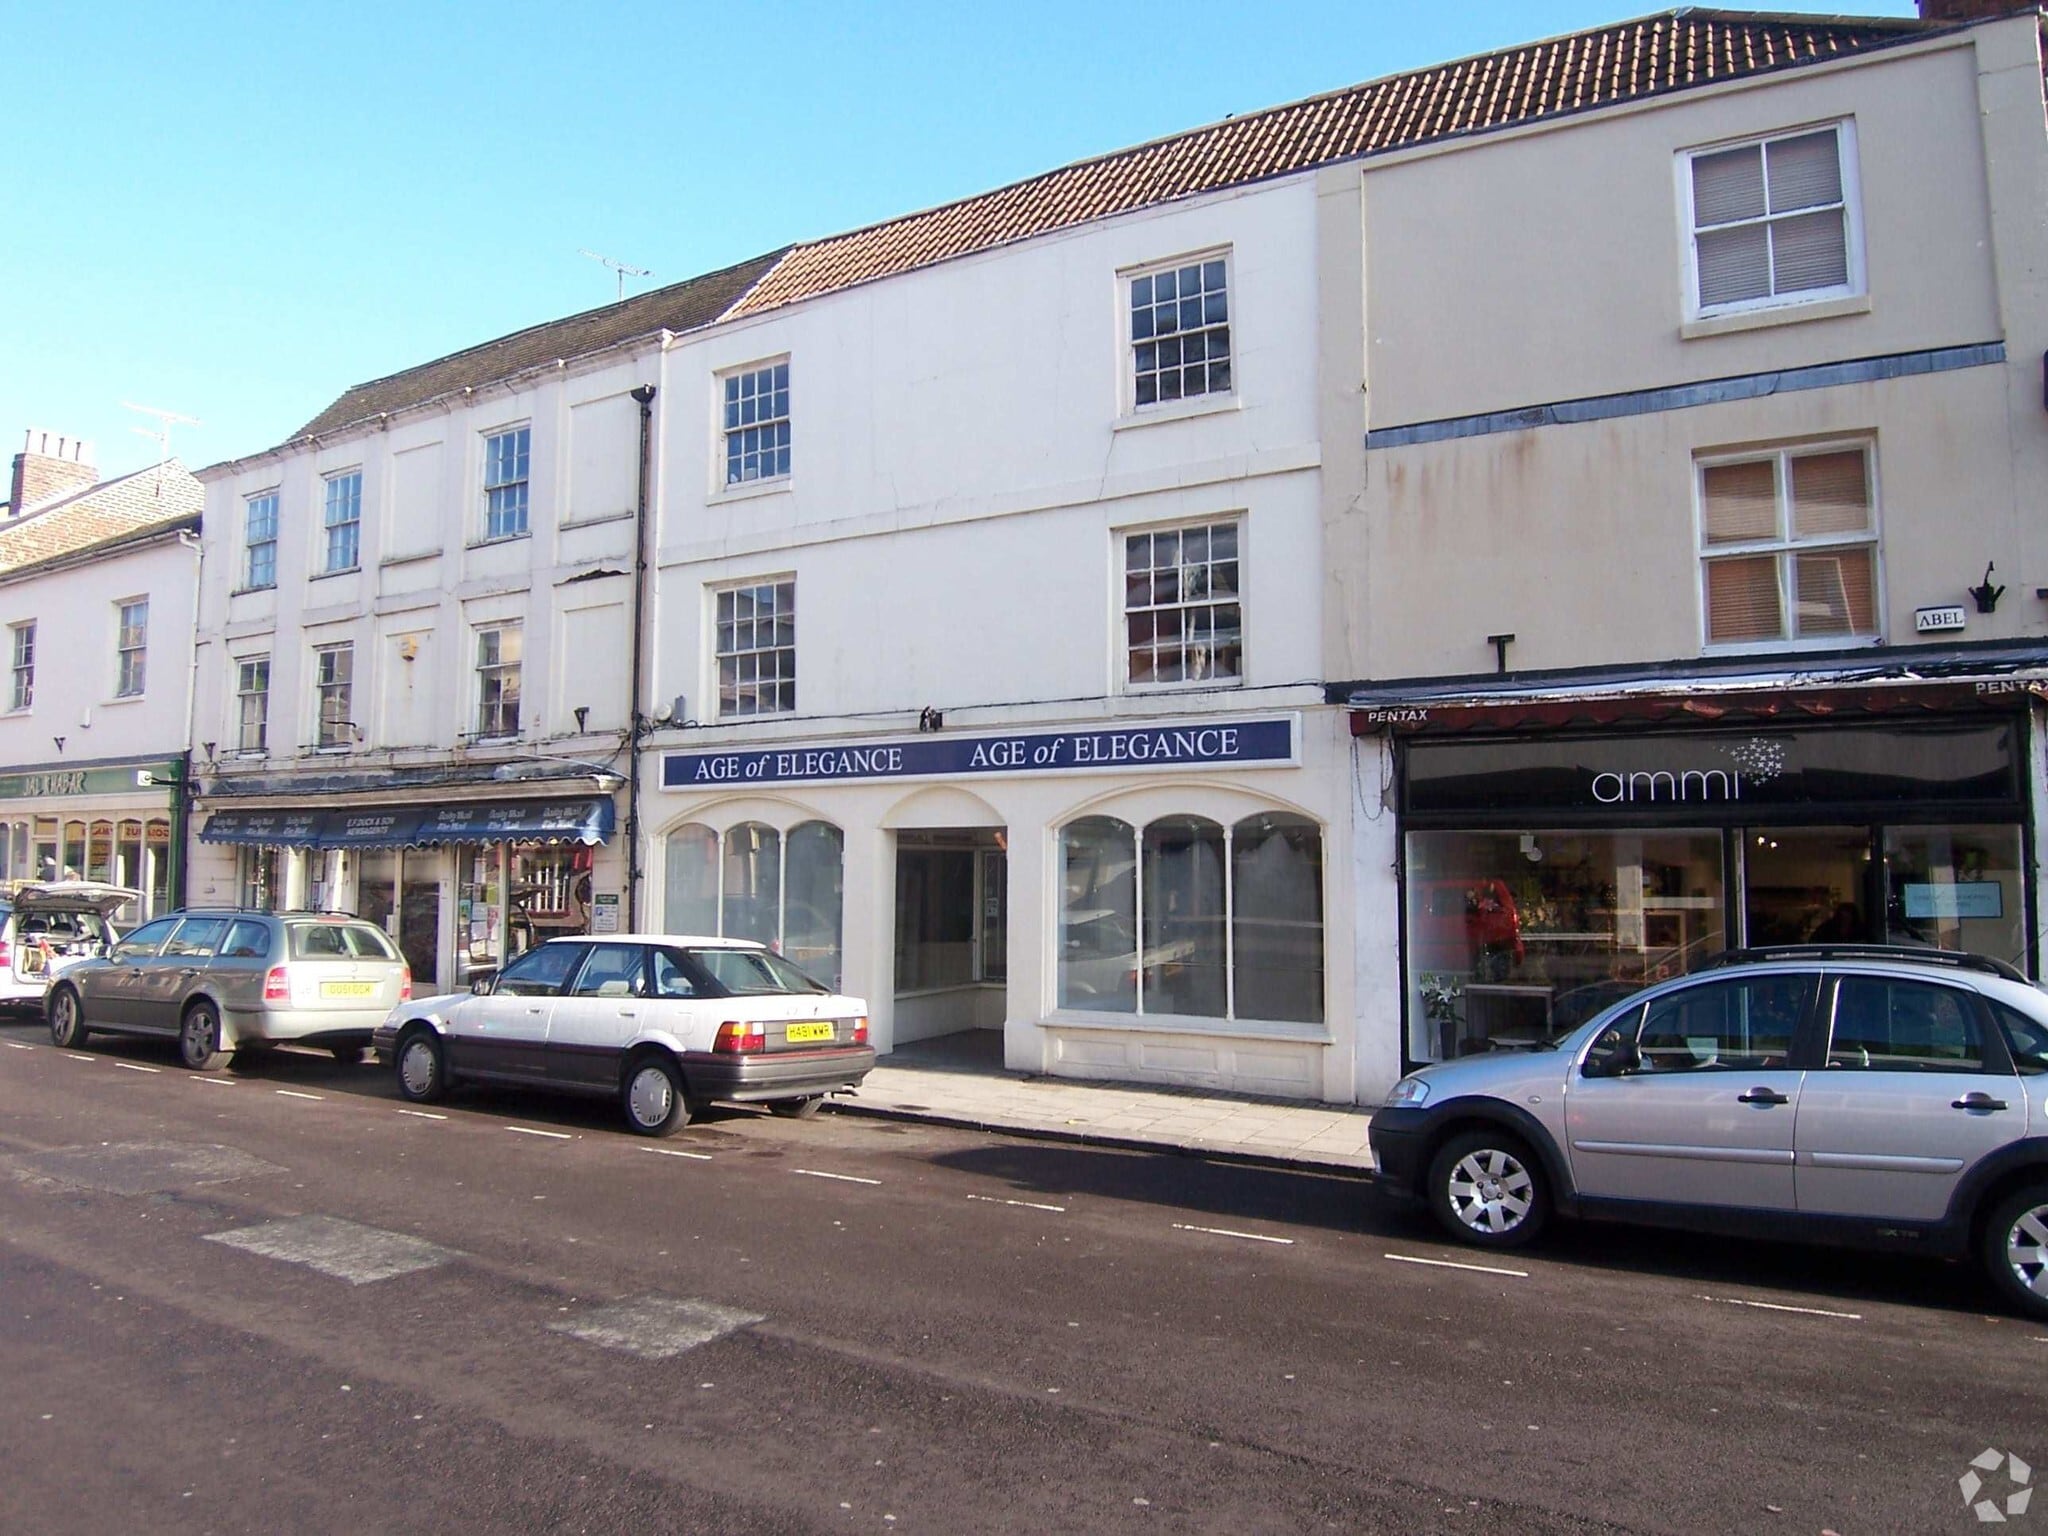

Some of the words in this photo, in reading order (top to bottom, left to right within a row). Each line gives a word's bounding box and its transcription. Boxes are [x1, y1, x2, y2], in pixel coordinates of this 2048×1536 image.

[1919, 611, 1963, 628] ABEL
[1368, 709, 1428, 722] PENTAX
[969, 740, 1027, 767] AGE
[1033, 737, 1065, 764] of
[1073, 728, 1240, 763] ELEGANCE
[695, 757, 740, 780] AGE
[745, 754, 771, 778] of
[776, 748, 904, 776] ELEGANCE
[1592, 769, 1739, 803] ammi
